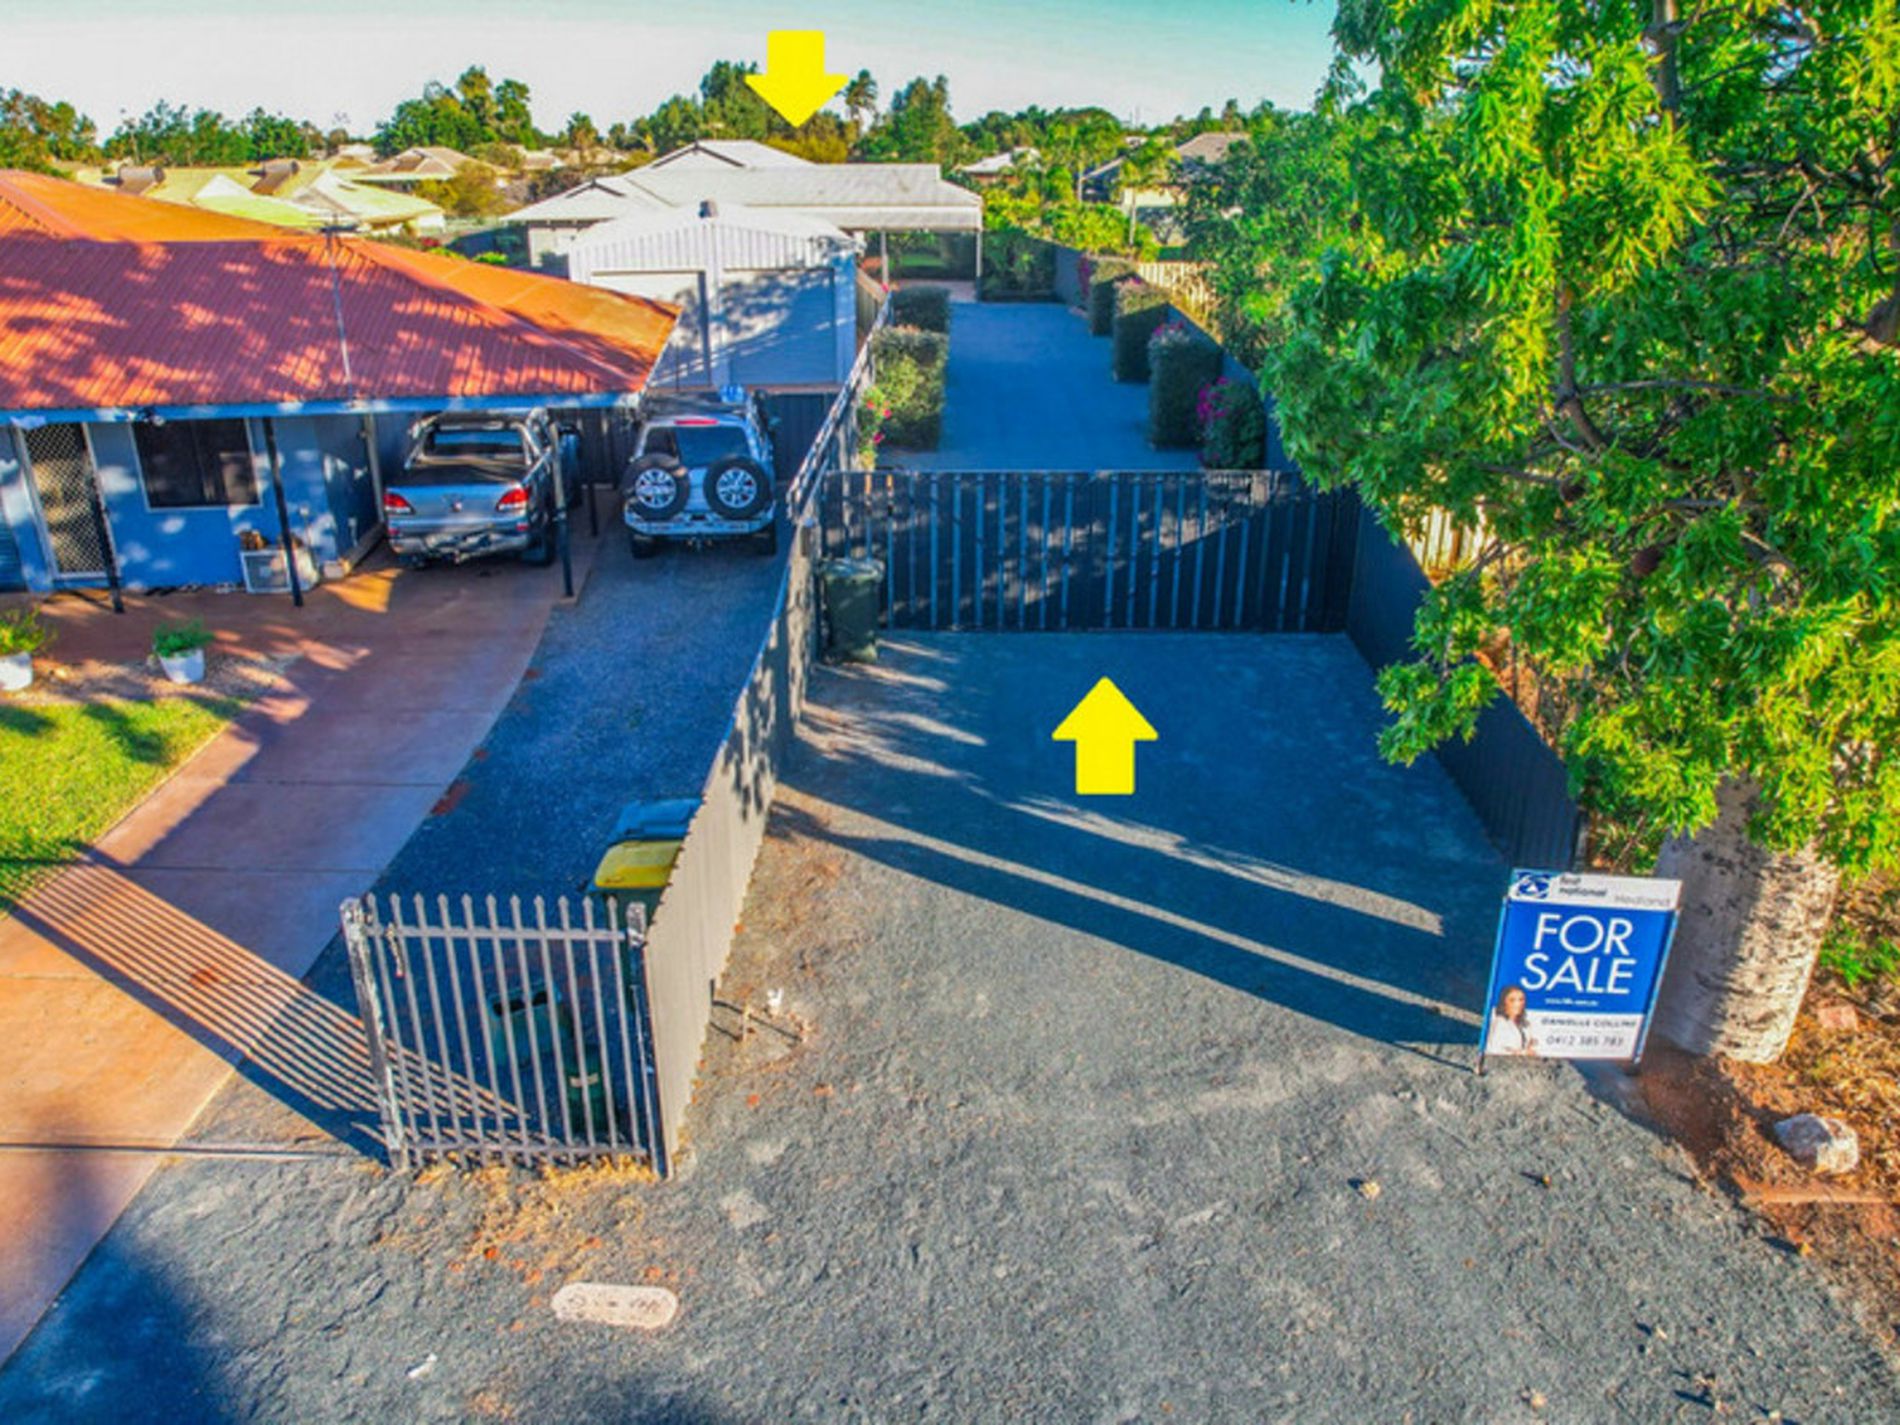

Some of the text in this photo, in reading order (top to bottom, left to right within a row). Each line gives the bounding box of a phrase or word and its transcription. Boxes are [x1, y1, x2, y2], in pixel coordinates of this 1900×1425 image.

[1559, 887, 1608, 897] national
[1535, 913, 1633, 956] FOR
[1520, 954, 1638, 995] SALE
